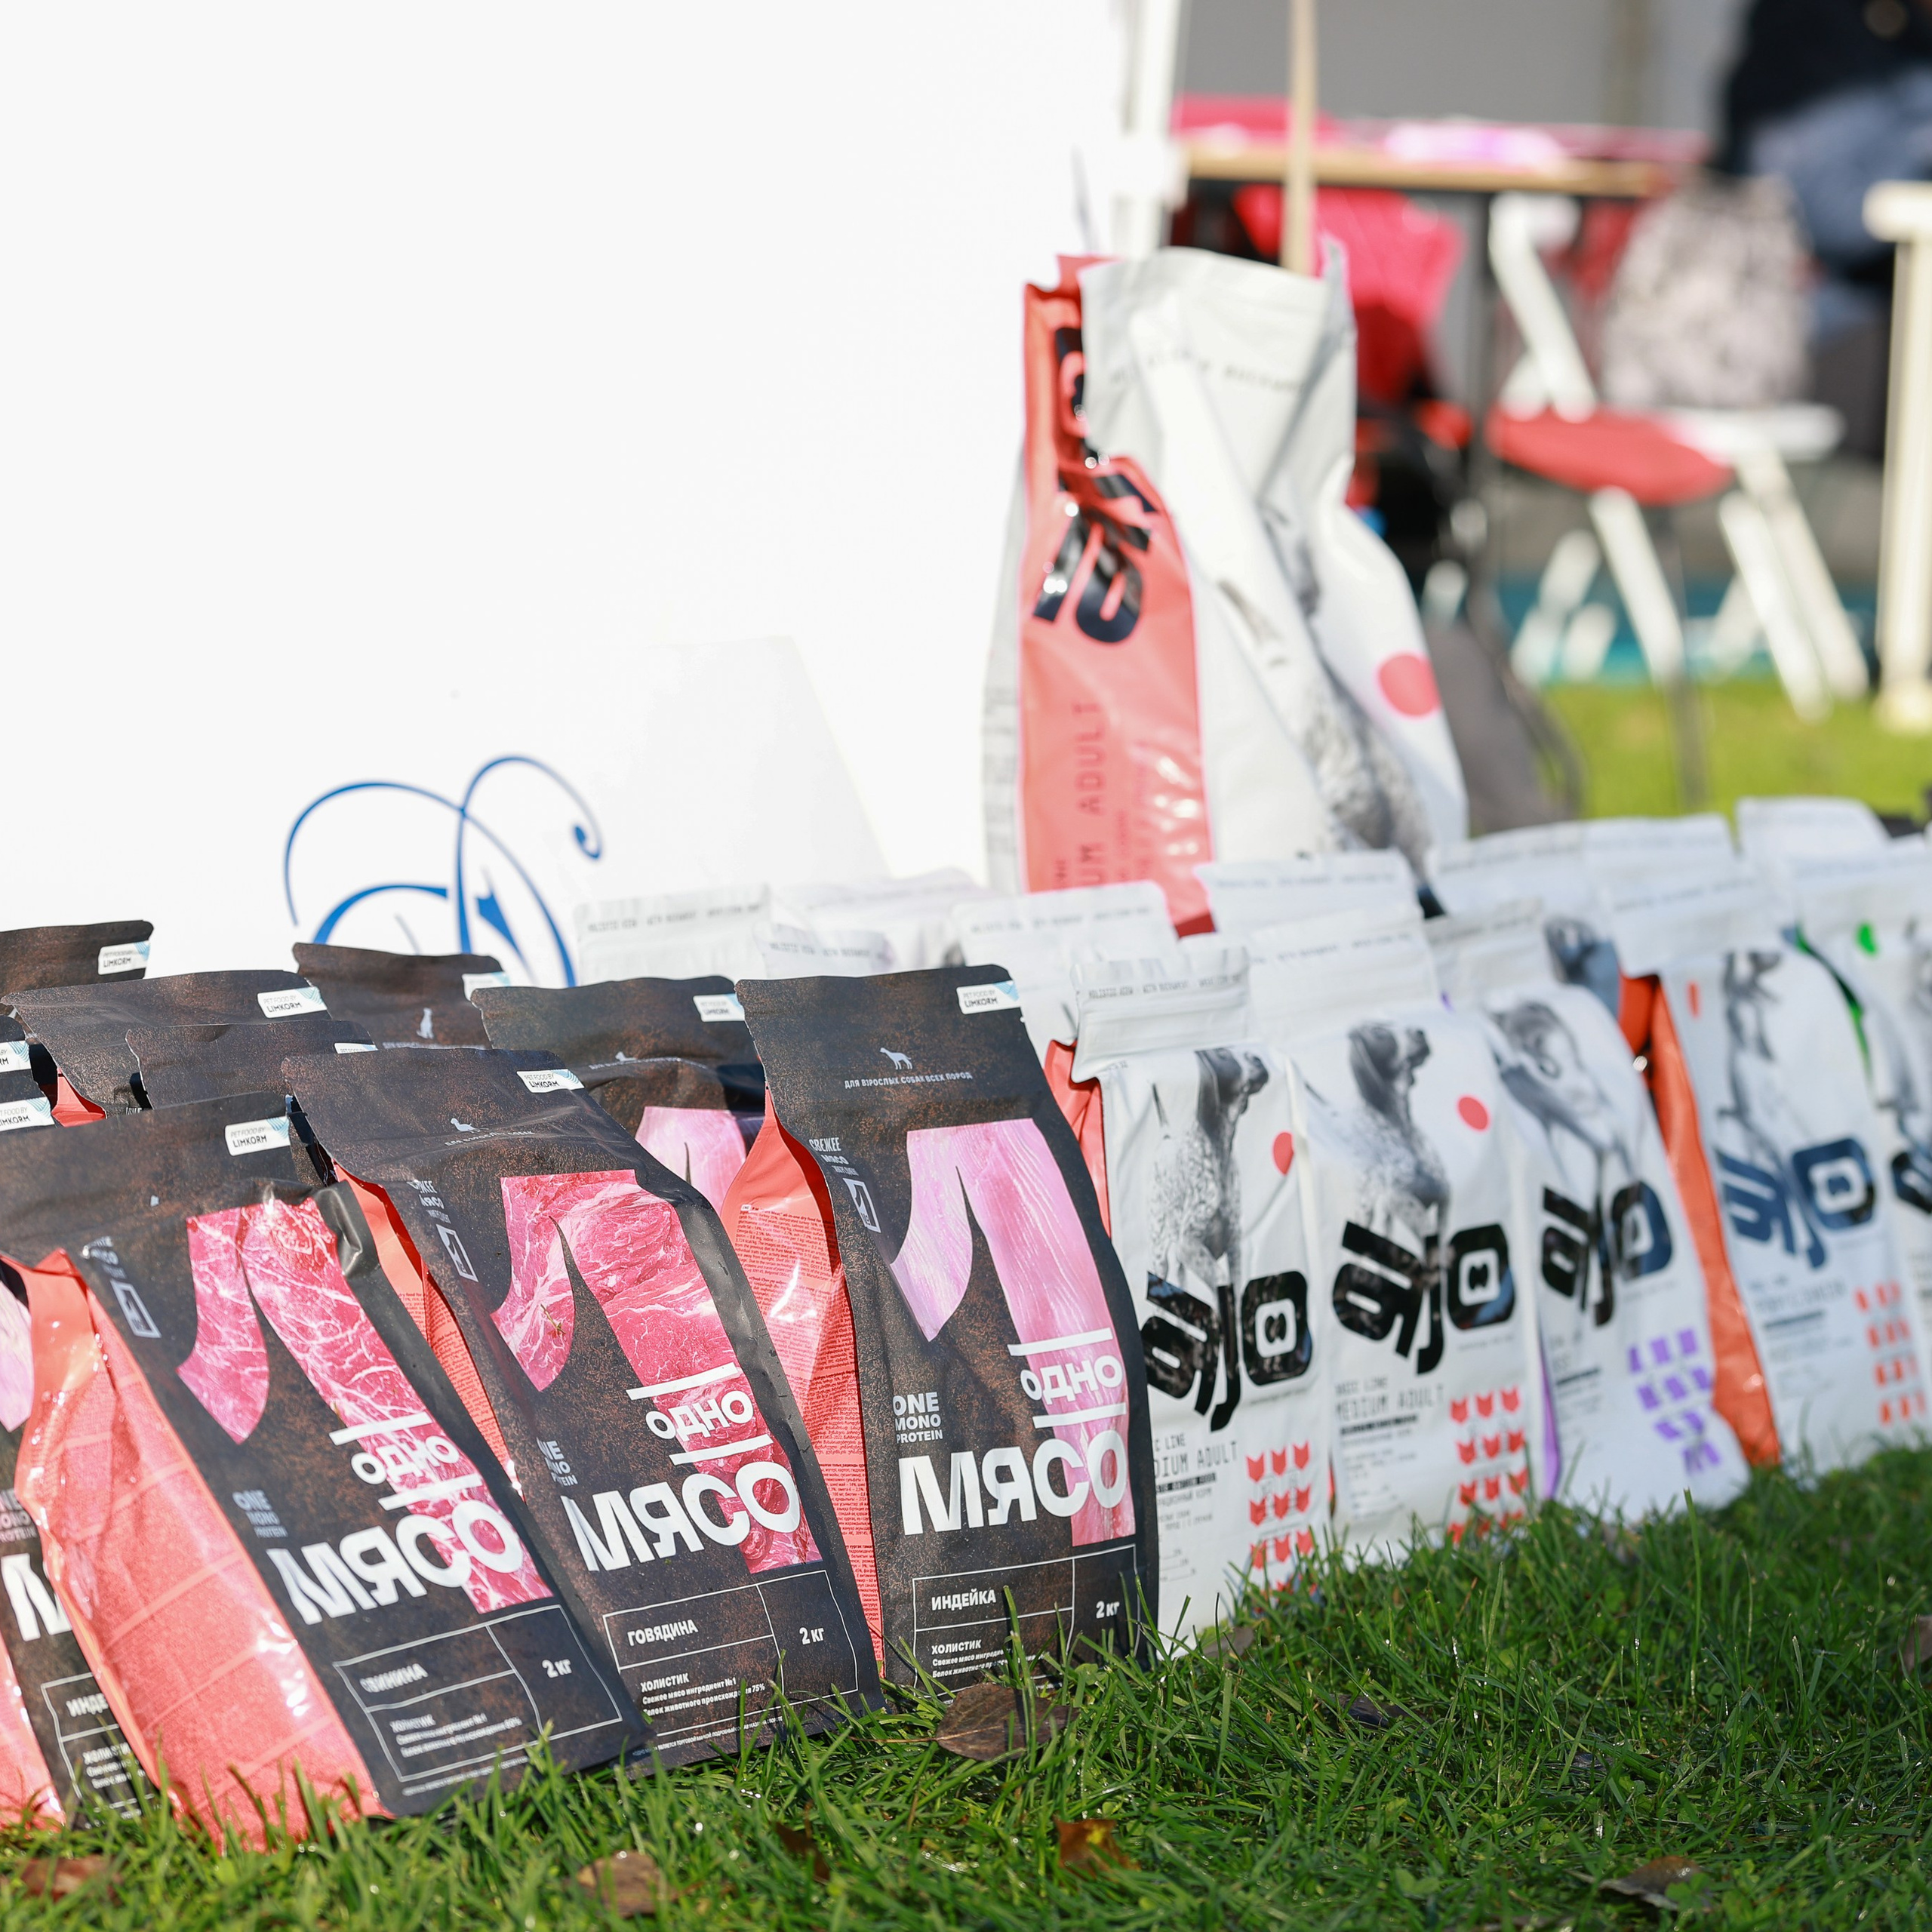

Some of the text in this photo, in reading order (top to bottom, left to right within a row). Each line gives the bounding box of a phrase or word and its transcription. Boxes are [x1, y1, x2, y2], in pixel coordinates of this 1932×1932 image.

[263, 996, 273, 1004] PET
[266, 1002, 302, 1013] LIMKORM
[528, 1081, 560, 1089] LIMKORM
[844, 1072, 973, 1089] ДЛЯ ВЗРОСЛЫХ СОБАК ВСЕХ ПОРОД
[232, 1135, 267, 1148] LIMKORM
[808, 1137, 841, 1152] СВЕЖЕЕ
[1333, 1220, 1516, 1375] ajo
[1141, 1270, 1313, 1432] ajo
[1021, 1354, 1124, 1404] ОДНО
[892, 1392, 939, 1416] ONE
[646, 1390, 754, 1441] ОДНО
[895, 1414, 941, 1432] MONO
[896, 1429, 943, 1444] PROTEIN
[1164, 1433, 1186, 1451] LINE
[351, 1436, 459, 1484] ОДНО
[1154, 1440, 1238, 1478] DIUM ADULT
[898, 1429, 1128, 1536] МЯСО
[232, 1490, 272, 1511] ONE
[0, 1511, 30, 1529] ONO
[561, 1460, 801, 1572] МЯСО
[267, 1500, 524, 1624] МЯСО
[931, 1588, 996, 1611] ИНДЕЙКА
[1096, 1601, 1105, 1619] 2
[627, 1619, 698, 1647] ГОВЯДИНА
[799, 1627, 810, 1645] 2
[931, 1639, 981, 1655] ХОЛИСТИК
[932, 1647, 1010, 1666] Свежее мясо ингредие
[542, 1659, 557, 1678] 2
[932, 1669, 952, 1678] Белок
[640, 1672, 690, 1693] ХОЛИСТИК
[642, 1677, 737, 1706] Свежее мясо ингредиент №1
[664, 1698, 701, 1713] животного
[752, 1683, 765, 1694] 75%
